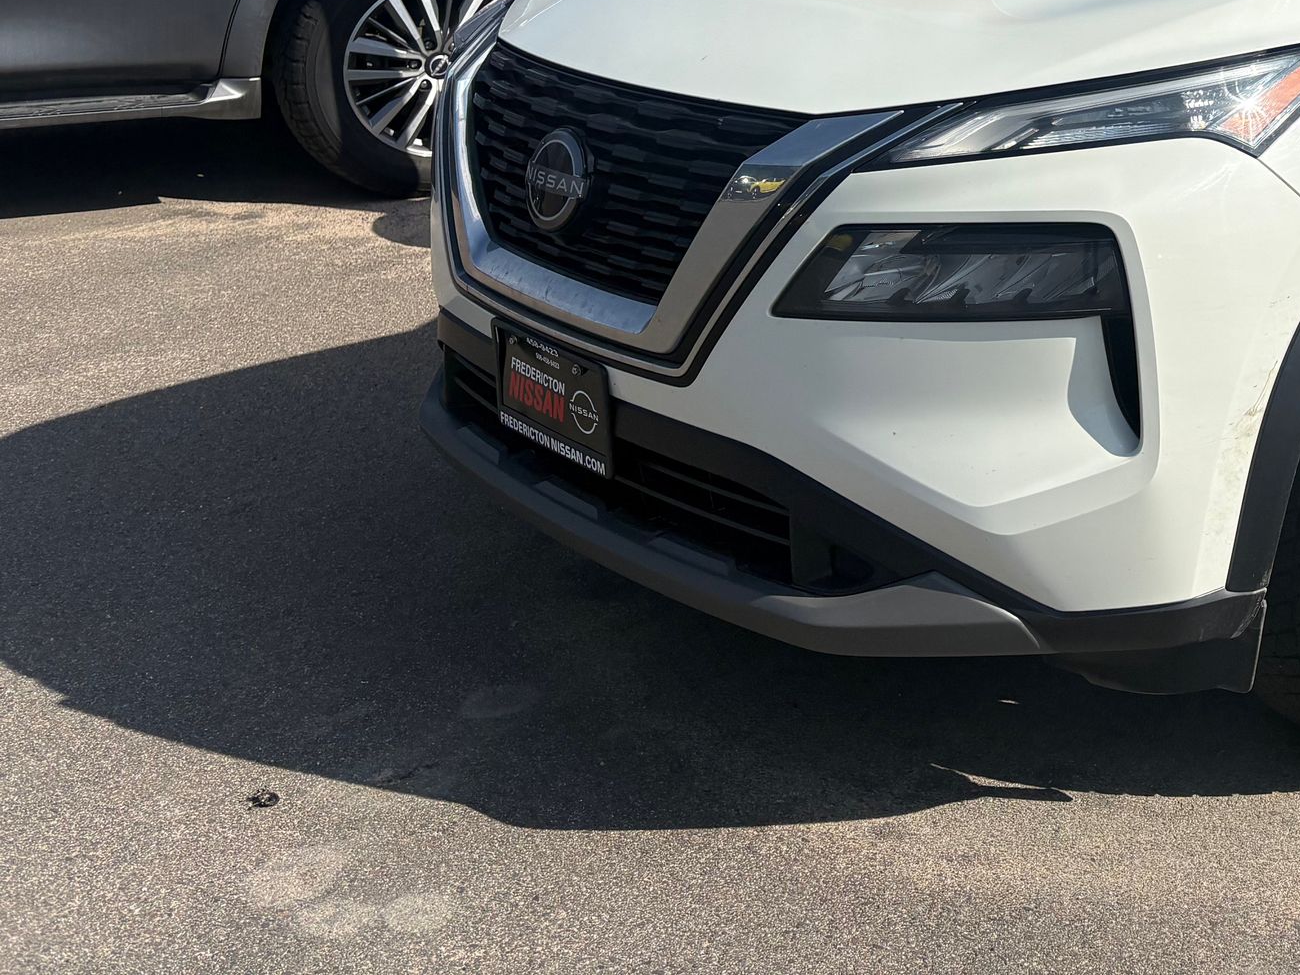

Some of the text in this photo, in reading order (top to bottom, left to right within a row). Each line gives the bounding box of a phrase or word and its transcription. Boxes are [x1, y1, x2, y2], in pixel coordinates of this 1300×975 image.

[526, 164, 585, 197] NISSAN
[511, 356, 566, 396] FREDERICTON
[508, 371, 567, 423] NISSAN
[568, 402, 600, 423] NISSAN
